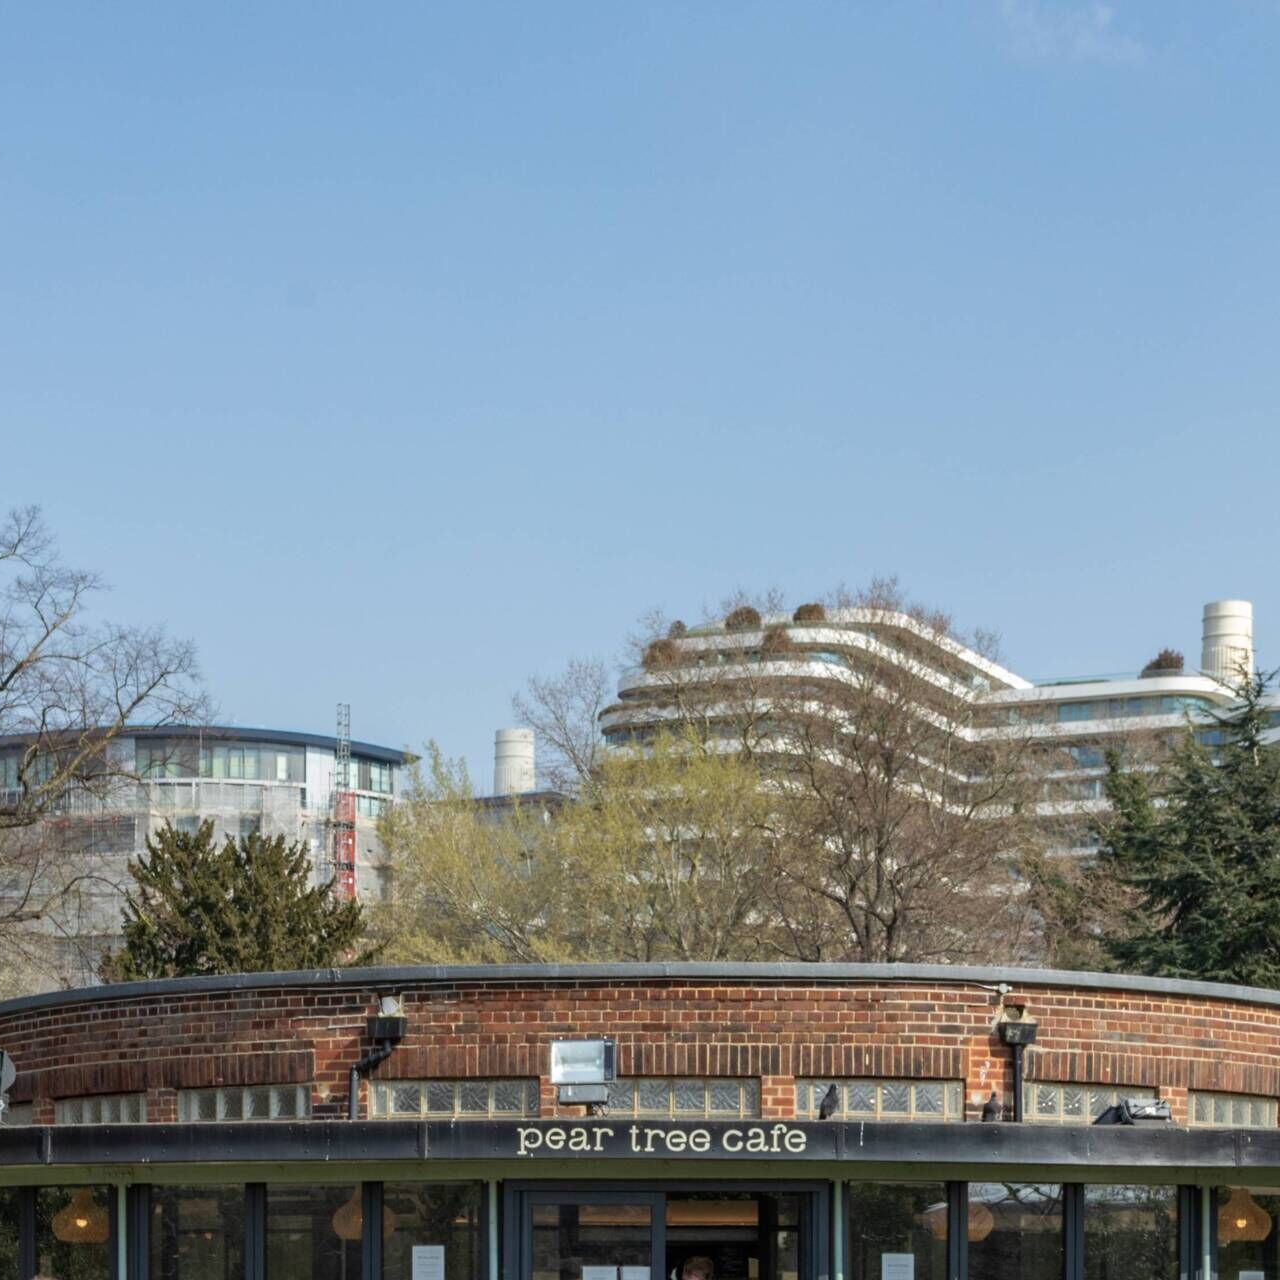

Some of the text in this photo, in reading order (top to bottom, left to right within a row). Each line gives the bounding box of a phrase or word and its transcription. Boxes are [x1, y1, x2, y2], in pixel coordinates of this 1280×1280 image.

[517, 1123, 808, 1155] pear tree cafe
